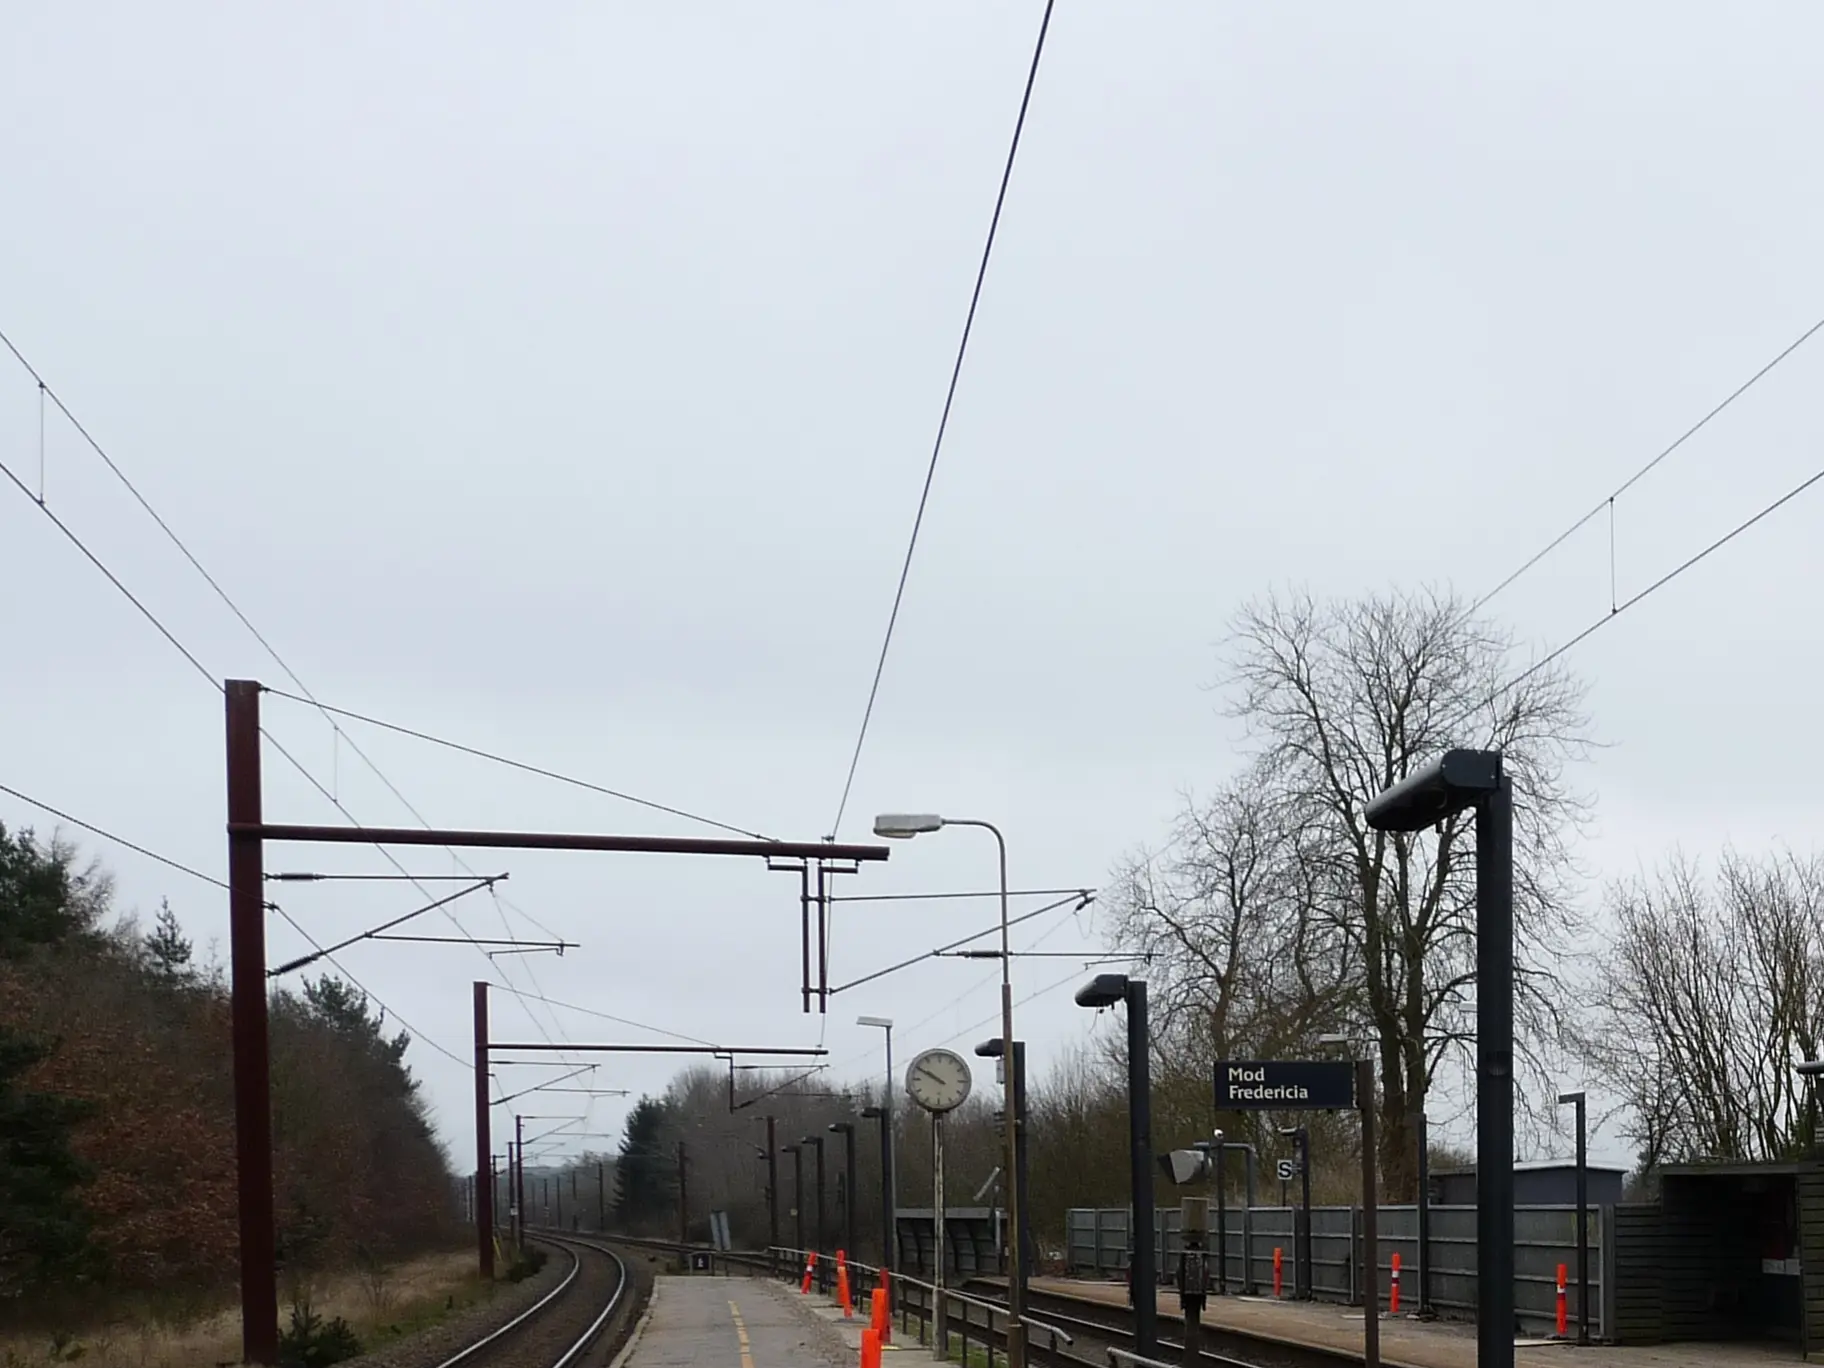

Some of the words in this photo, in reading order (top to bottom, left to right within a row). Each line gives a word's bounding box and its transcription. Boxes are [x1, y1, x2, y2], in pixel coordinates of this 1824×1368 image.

[1228, 1067, 1265, 1082] Mod
[1229, 1085, 1309, 1100] Fredericia
[1279, 1161, 1292, 1178] S
